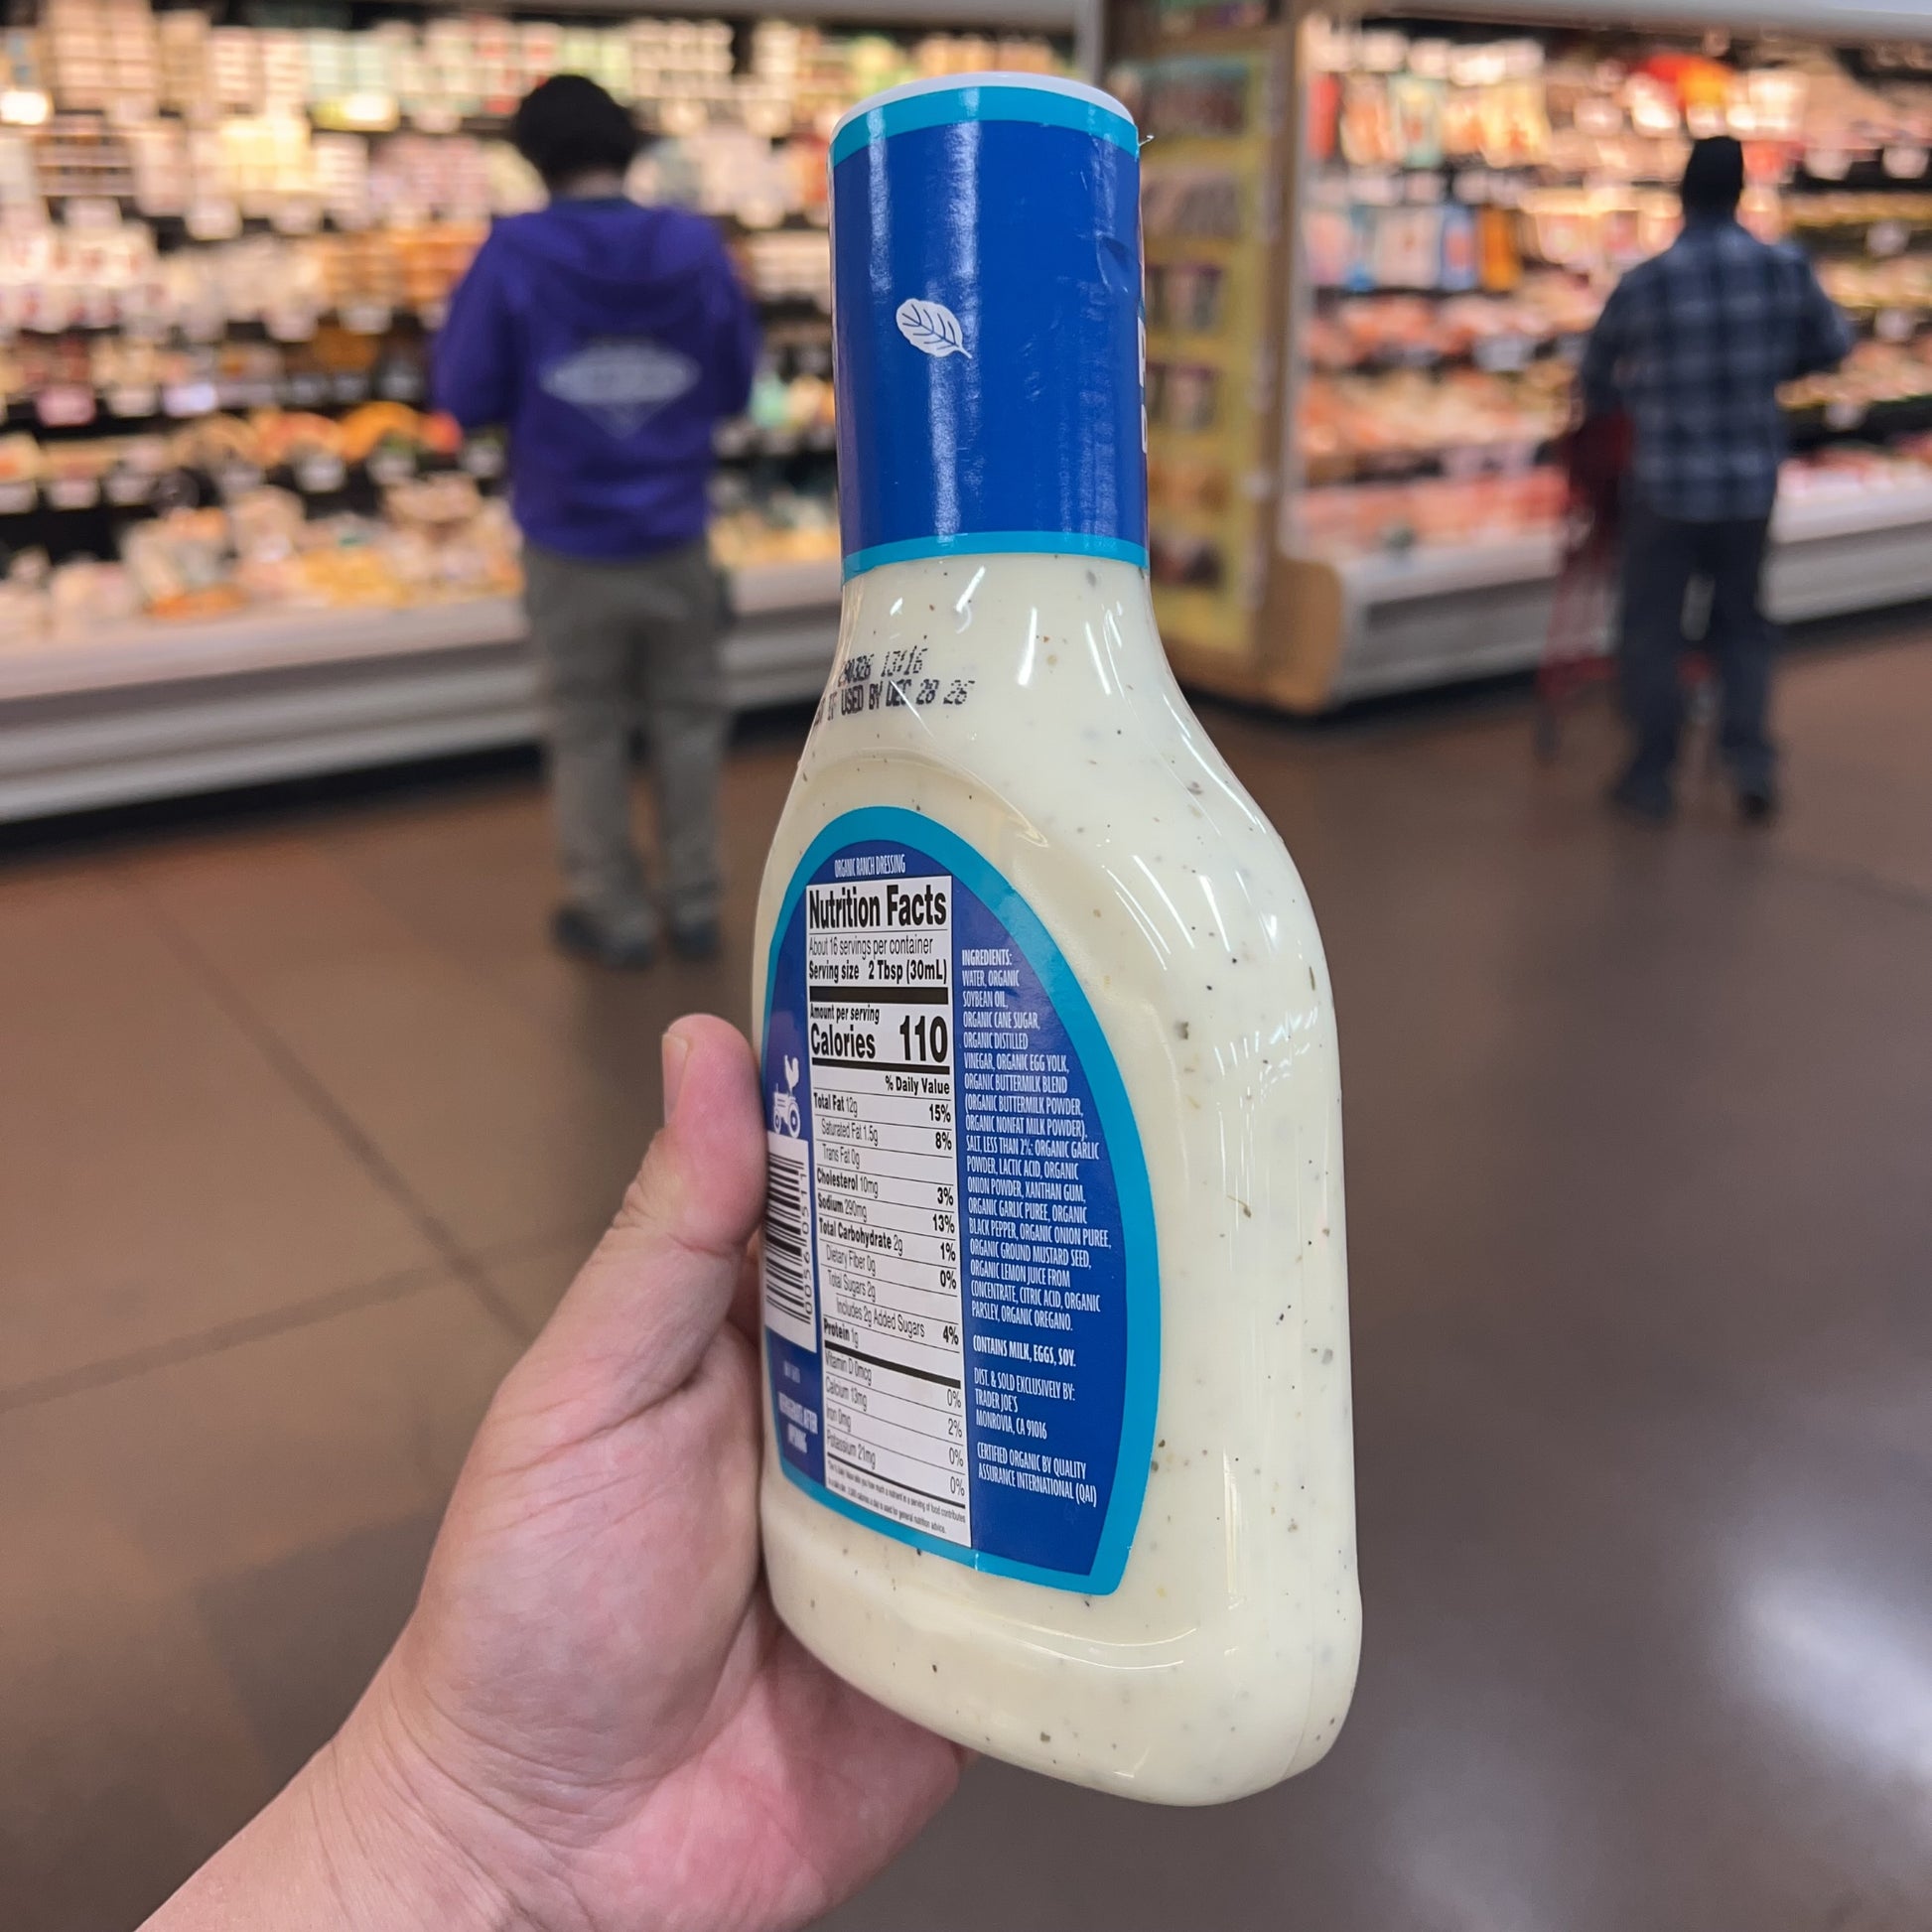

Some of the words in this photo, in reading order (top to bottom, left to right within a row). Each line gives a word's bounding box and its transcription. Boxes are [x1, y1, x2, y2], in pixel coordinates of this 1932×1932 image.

[835, 858, 855, 878] ORGANIC
[856, 856, 875, 876] RANCH
[876, 854, 905, 875] DRESSING
[809, 887, 880, 929] Nutrition
[887, 885, 946, 926] Facts
[809, 937, 828, 956] About
[830, 937, 838, 955] 16
[840, 935, 872, 960] servings
[874, 942, 888, 958] per
[890, 934, 933, 954] container
[962, 949, 1013, 966] INGREDIENTS:
[809, 961, 839, 983] Serving
[842, 961, 859, 980] size
[869, 962, 874, 979] 2
[878, 960, 902, 983] Tbsp
[906, 959, 947, 984] (30mL)
[962, 970, 987, 989] WATER,
[989, 970, 1020, 987] ORGANIC
[963, 991, 993, 1007] SOYBEAN
[995, 991, 1009, 1010] OIL,
[810, 1006, 835, 1020] Amount
[836, 1009, 848, 1024] per
[851, 1005, 880, 1025] serving
[963, 1012, 993, 1028] ORGANIC
[995, 1012, 1012, 1029] CANE
[1014, 1012, 1040, 1032] SUGAR,
[811, 1023, 876, 1059] Calories
[899, 1015, 948, 1062] 110
[964, 1032, 993, 1048] ORGANIC
[994, 1033, 1029, 1049] DISTILLED
[964, 1052, 995, 1071] VINEGAR,
[997, 1053, 1029, 1071] ORGANIC
[1031, 1054, 1044, 1071] EGG
[1046, 1054, 1069, 1074] YOLK,
[896, 1076, 918, 1096] Daily
[921, 1078, 950, 1094] Value
[964, 1073, 994, 1091] ORGANIC
[996, 1074, 1040, 1092] BUTTERMILK
[1042, 1076, 1067, 1093] BLEND
[813, 1092, 831, 1109] Total
[833, 1094, 844, 1112] Fat
[846, 1097, 858, 1118] 12g
[929, 1104, 951, 1123] 15%
[965, 1094, 997, 1114] (ORGANIC
[999, 1095, 1044, 1114] BUTTERMILK
[1046, 1097, 1083, 1117] POWDER,
[852, 1123, 862, 1141] Fat
[864, 1125, 878, 1146] 1.5g
[966, 1114, 995, 1132] ORGANIC
[997, 1117, 1024, 1134] NONFAT
[1026, 1118, 1044, 1135] MILK
[935, 1132, 952, 1151] 8%
[967, 1135, 982, 1154] SALT,
[984, 1137, 997, 1153] LESS
[999, 1138, 1019, 1155] THAN
[1035, 1140, 1069, 1158] ORGANIC
[1071, 1142, 1100, 1160] GARLIC
[823, 1144, 839, 1162] Trans
[840, 1147, 850, 1164] Fat
[852, 1149, 860, 1170] 0g
[967, 1156, 998, 1175] POWDER,
[999, 1159, 1022, 1175] LACTIC
[1024, 1160, 1042, 1177] ACID,
[1044, 1162, 1079, 1180] ORGANIC
[817, 1168, 858, 1191] Cholesterol
[860, 1176, 879, 1198] 10mg
[968, 1176, 989, 1194] ONION
[991, 1179, 1024, 1198] POWDER,
[1026, 1181, 1061, 1200] XANTHAN
[1063, 1183, 1086, 1203] GUM,
[818, 1192, 843, 1214] Sodium
[937, 1186, 954, 1206] 3%
[968, 1197, 997, 1216] ORGANIC
[999, 1200, 1024, 1218] GARLIC
[1025, 1202, 1050, 1222] PUREE,
[1052, 1205, 1087, 1224] ORGANIC
[933, 1213, 955, 1234] 13%
[969, 1217, 989, 1235] BLACK
[991, 1220, 1019, 1240] PEPPER,
[1020, 1223, 1052, 1242] ORGANIC
[1054, 1226, 1081, 1244] ONION
[1083, 1229, 1111, 1249] PUREE,
[819, 1217, 836, 1236] Total
[838, 1222, 892, 1249] Carbohydrate
[894, 1235, 903, 1256] 2g
[849, 1250, 866, 1269] Fiber
[867, 1255, 876, 1277] 0g
[940, 1242, 955, 1262] 1%
[970, 1238, 999, 1258] ORGANIC
[1001, 1242, 1031, 1262] GROUND
[1033, 1246, 1069, 1266] MUSTARD
[1071, 1249, 1091, 1269] SEED,
[940, 1270, 956, 1290] 0%
[971, 1259, 1000, 1279] ORGANIC
[1001, 1263, 1027, 1283] LEMON
[1027, 1267, 1046, 1285] JUICE
[1047, 1269, 1070, 1288] FROM
[828, 1270, 842, 1289] Total
[844, 1274, 866, 1298] Sugars
[867, 1281, 876, 1303] 2g
[971, 1280, 1019, 1305] CONCENTRATE,
[1020, 1287, 1041, 1307] CITRIC
[1043, 1290, 1063, 1310] ACID,
[1064, 1293, 1100, 1311] ORGANIC
[864, 1306, 872, 1327] 2g
[874, 1308, 896, 1330] Added
[897, 1313, 924, 1339] Sugars
[972, 1301, 1000, 1322] PARSLEY,
[1001, 1306, 1033, 1325] ORGANIC
[1035, 1311, 1073, 1331] OREGANO.
[824, 1317, 850, 1341] Protein
[943, 1325, 959, 1345] 4%
[973, 1335, 1008, 1356] CONTAINS
[1009, 1340, 1032, 1362] MILK,
[1034, 1344, 1056, 1366] EGGS,
[1058, 1348, 1076, 1366] SOY.
[974, 1367, 990, 1387] DIST.
[991, 1371, 997, 1388] &
[998, 1372, 1015, 1391] SOLD
[1017, 1375, 1061, 1399] EXCLUSIVELY
[1063, 1382, 1075, 1401] BY:
[947, 1389, 961, 1409] 0%
[975, 1388, 1000, 1410] TRADER
[1001, 1394, 1019, 1413] JOE'S
[948, 1419, 962, 1438] 2%
[976, 1409, 1015, 1435] MONROVIA,
[1016, 1418, 1026, 1436] CA
[1027, 1419, 1047, 1440] 91016
[977, 1442, 1008, 1464] CERTIFIED
[1010, 1449, 1040, 1471] ORGANIC
[1042, 1455, 1051, 1473] BY
[1053, 1457, 1086, 1479] QUALITY
[979, 1462, 1016, 1487] ASSURANCE
[1017, 1471, 1074, 1499] INTERNATIONAL
[1075, 1482, 1096, 1508] (QAI)
